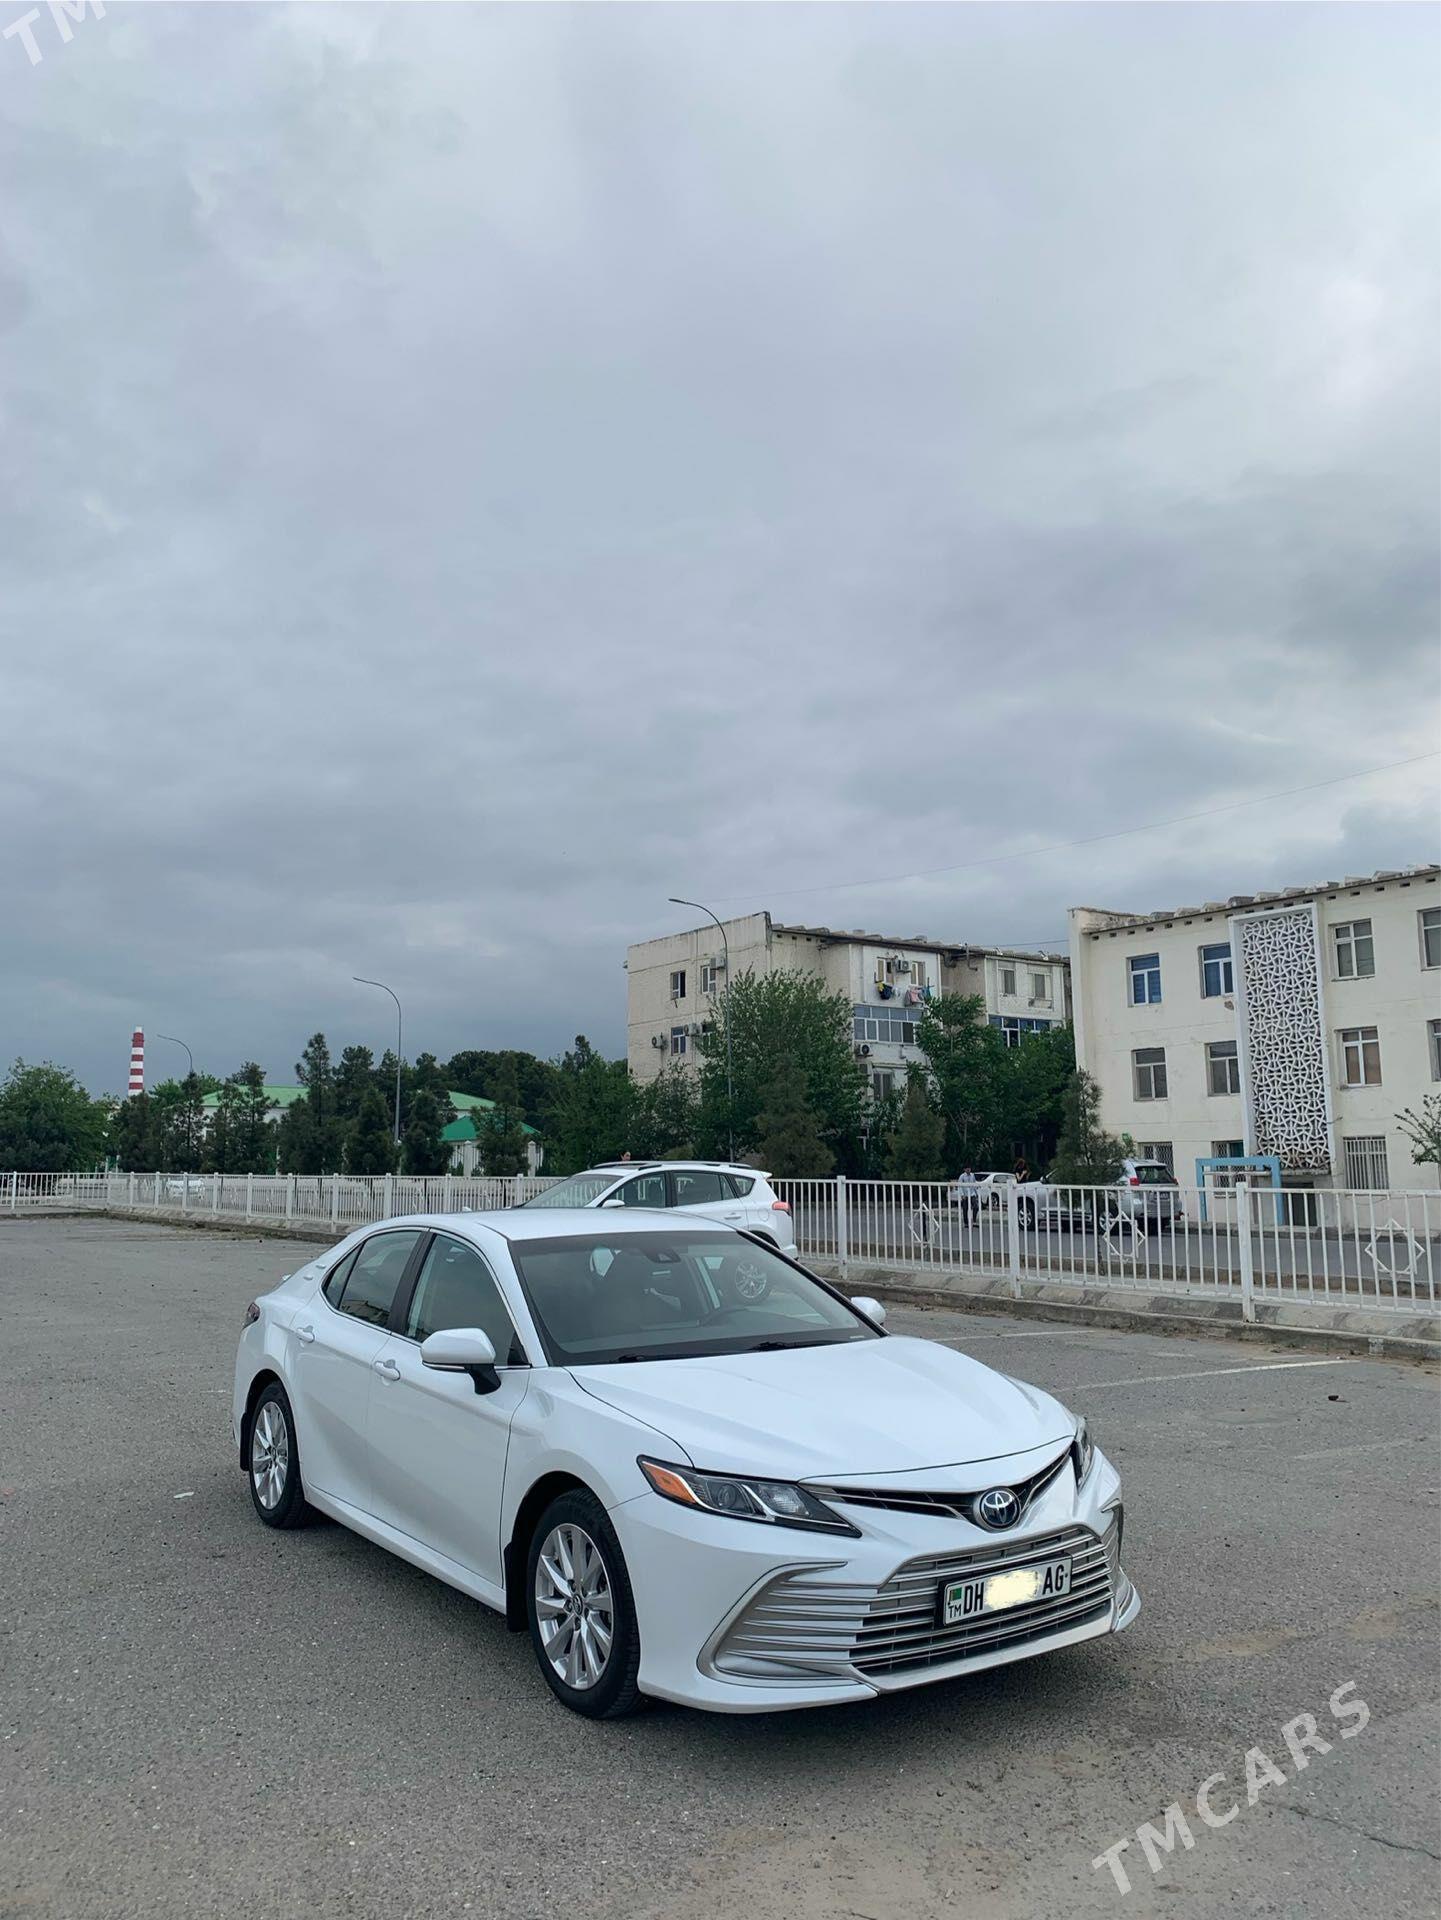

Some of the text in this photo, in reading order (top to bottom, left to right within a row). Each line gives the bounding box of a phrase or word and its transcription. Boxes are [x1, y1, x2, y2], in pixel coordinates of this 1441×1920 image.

[964, 1564, 1064, 1614] DH AG
[949, 1604, 962, 1618] TM
